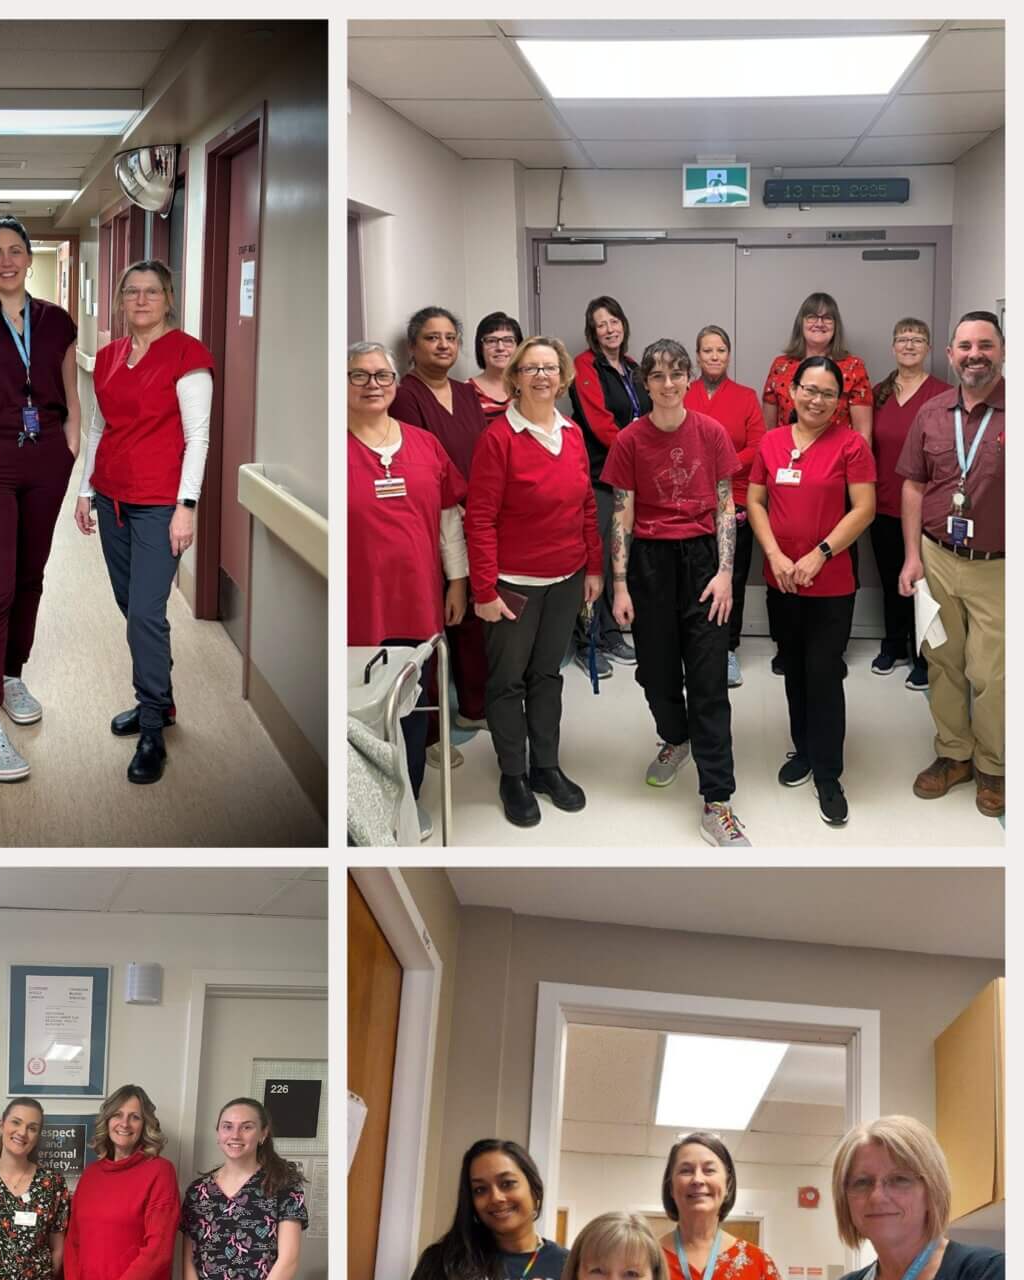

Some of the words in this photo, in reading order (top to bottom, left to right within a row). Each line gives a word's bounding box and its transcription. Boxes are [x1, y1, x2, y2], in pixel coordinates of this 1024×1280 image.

[784, 184, 803, 198] 13
[812, 184, 841, 198] FEB
[270, 1084, 289, 1094] 226
[41, 1128, 76, 1139] espect
[46, 1139, 63, 1149] and
[38, 1148, 77, 1159] ersonal
